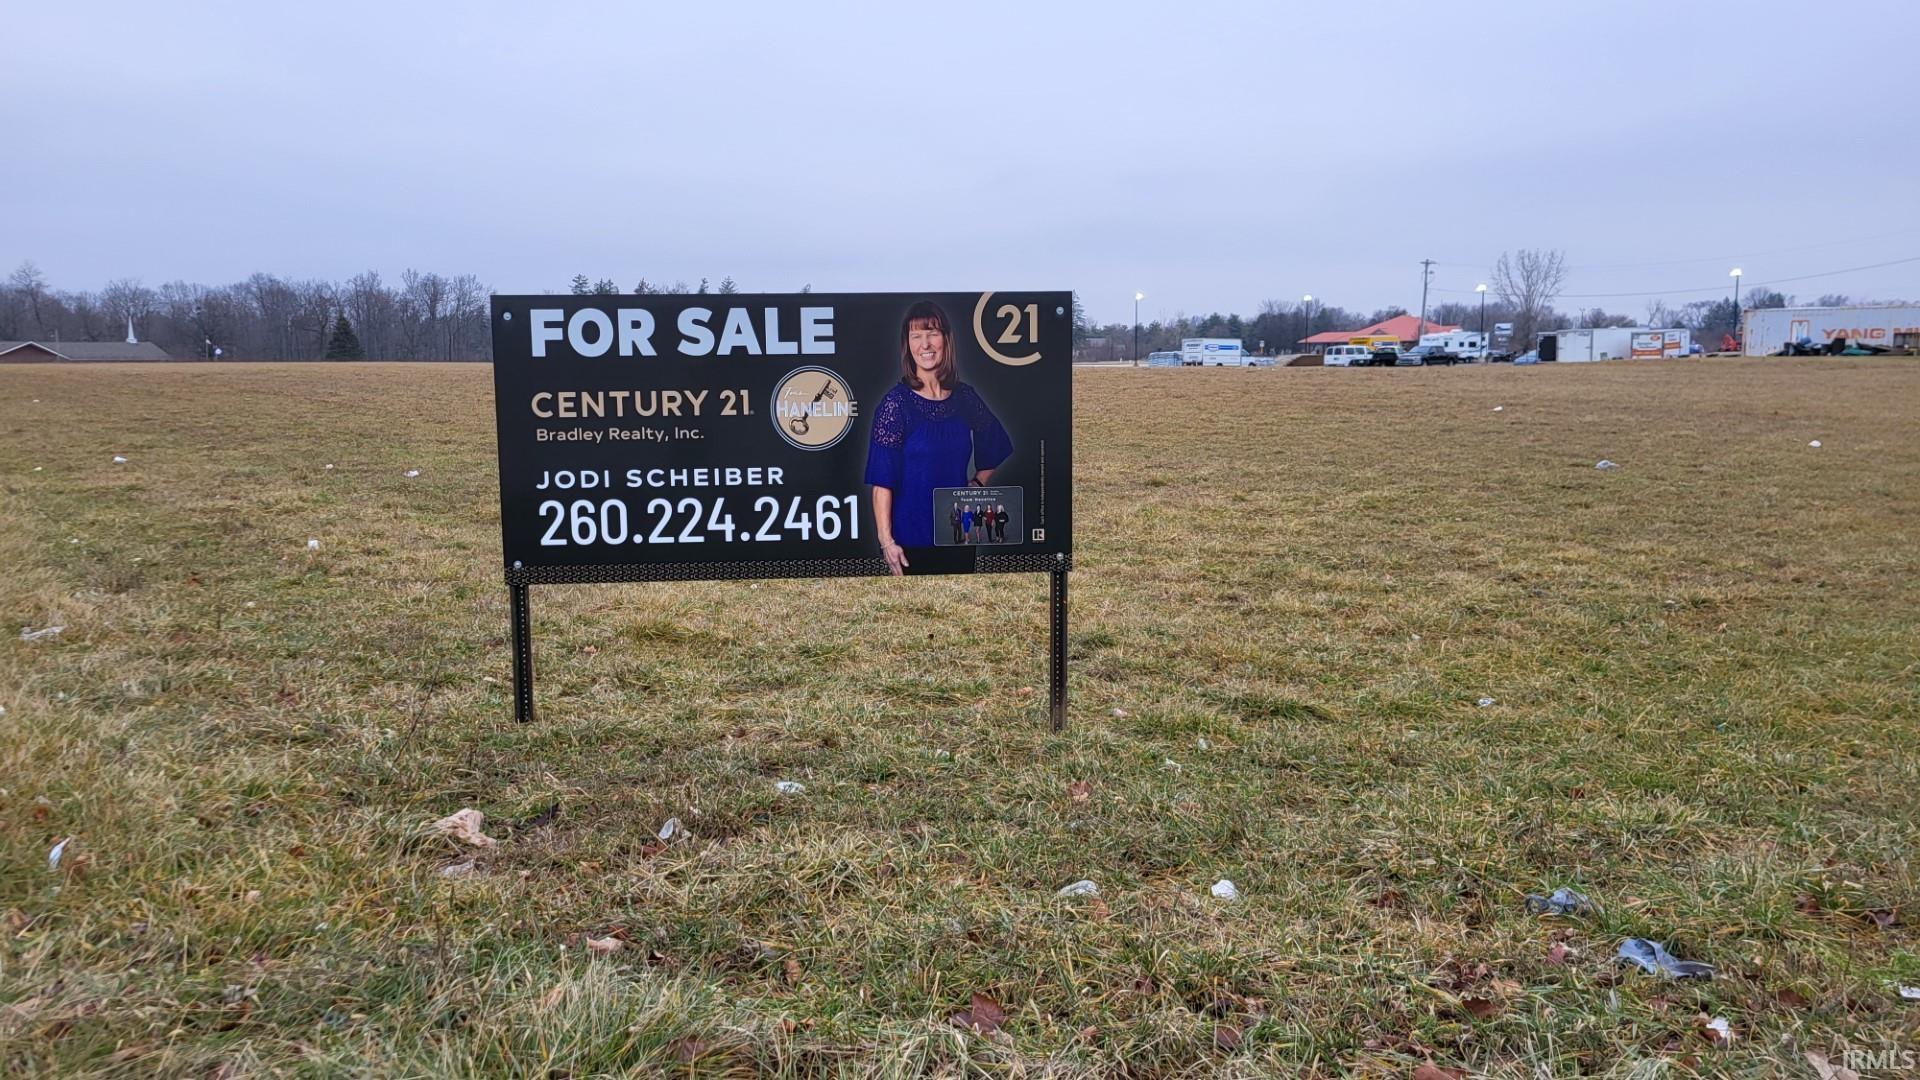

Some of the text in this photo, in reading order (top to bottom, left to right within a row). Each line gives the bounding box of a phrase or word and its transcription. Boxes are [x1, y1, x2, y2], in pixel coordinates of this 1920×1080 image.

[530, 307, 835, 357] FOR SALE
[996, 304, 1038, 343] 21
[1822, 328, 1886, 339] YANG
[531, 390, 708, 418] CENTURY
[776, 400, 858, 417] HANELINE
[536, 427, 705, 443] Bradley Realty, Inc.
[536, 467, 784, 490] JODI SCHEIBER
[538, 495, 859, 546] 260.224.2461
